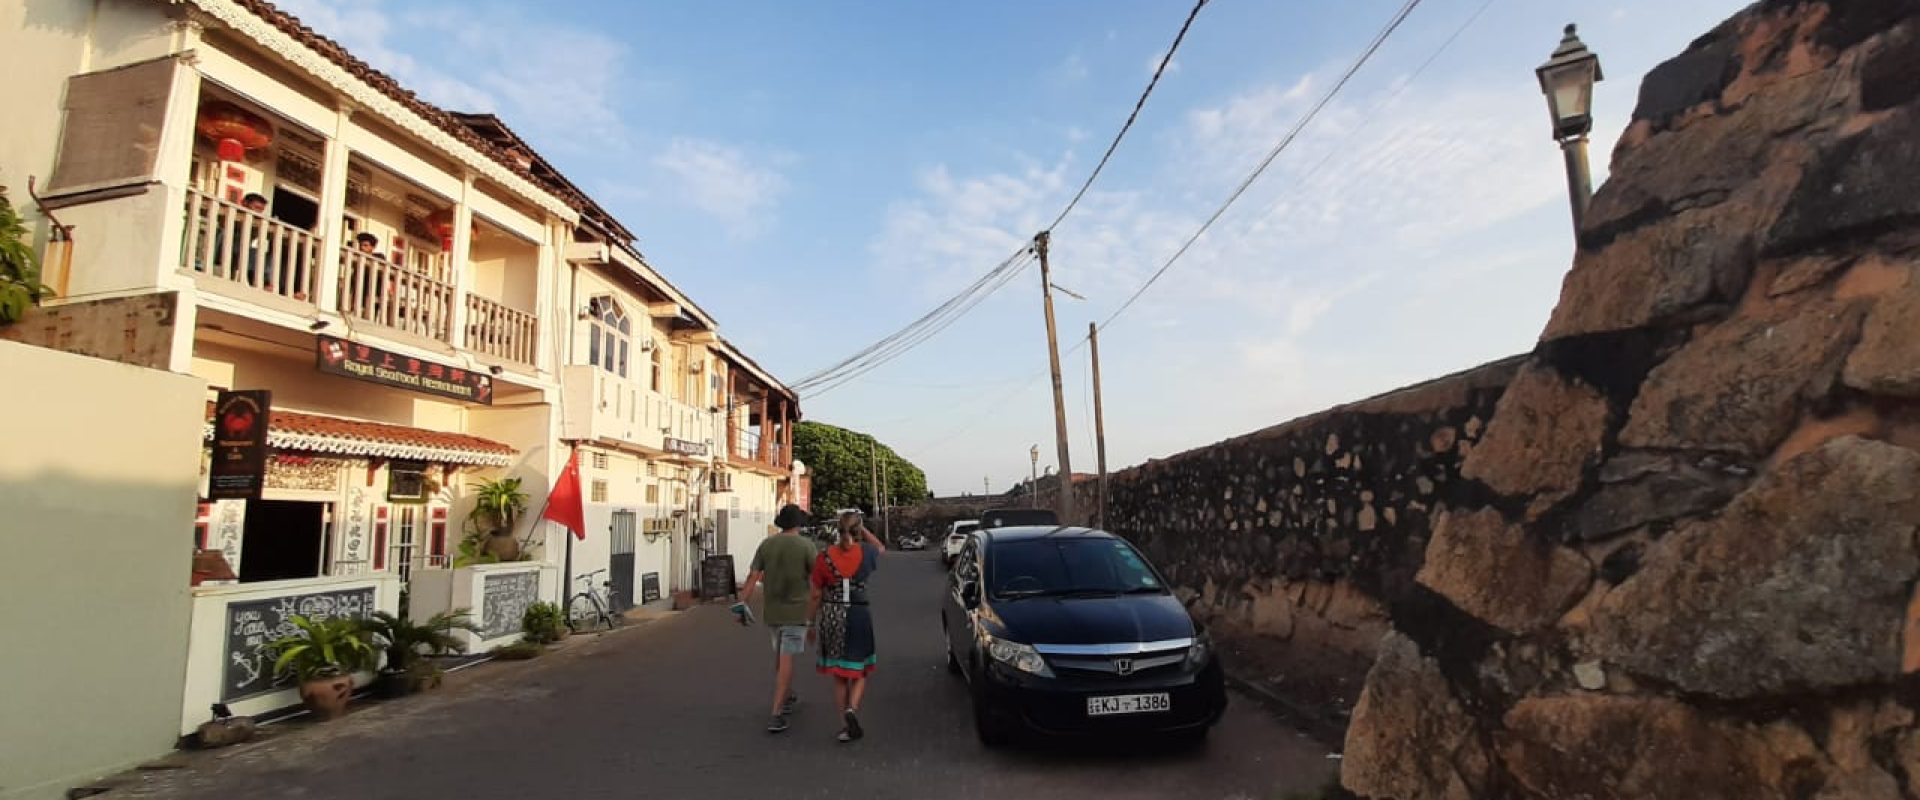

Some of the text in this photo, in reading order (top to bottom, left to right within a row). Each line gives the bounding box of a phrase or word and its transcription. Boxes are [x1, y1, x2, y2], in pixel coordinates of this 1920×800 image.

[344, 359, 472, 397] Royal Seafood Restaurant
